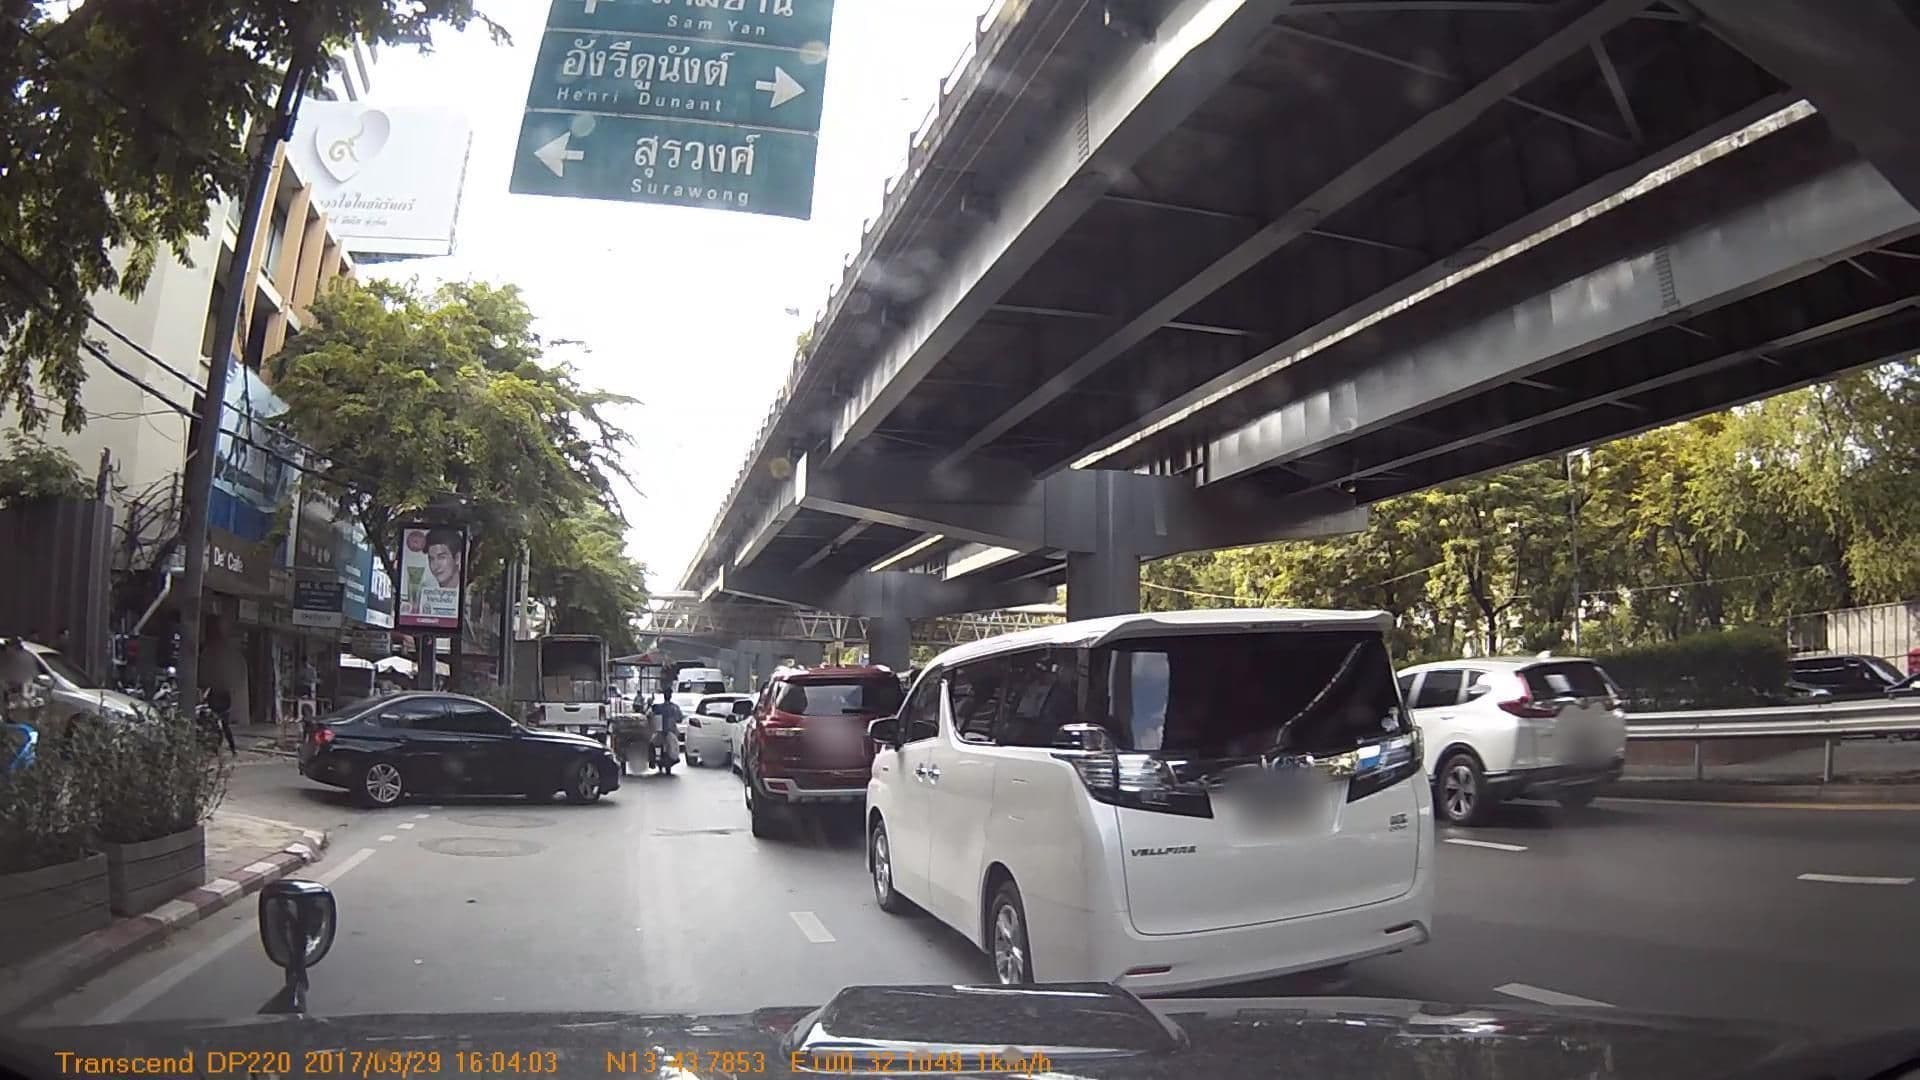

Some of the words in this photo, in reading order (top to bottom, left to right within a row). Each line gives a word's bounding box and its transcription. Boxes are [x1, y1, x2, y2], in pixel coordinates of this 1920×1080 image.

[667, 14, 713, 30] Sam
[727, 20, 766, 36] Yan
[562, 38, 736, 90] อังรีดูนังต์
[556, 87, 619, 104] Henri
[638, 92, 722, 113] Dunant
[633, 134, 761, 178] สุรวงศ์
[631, 178, 750, 206] Surawong
